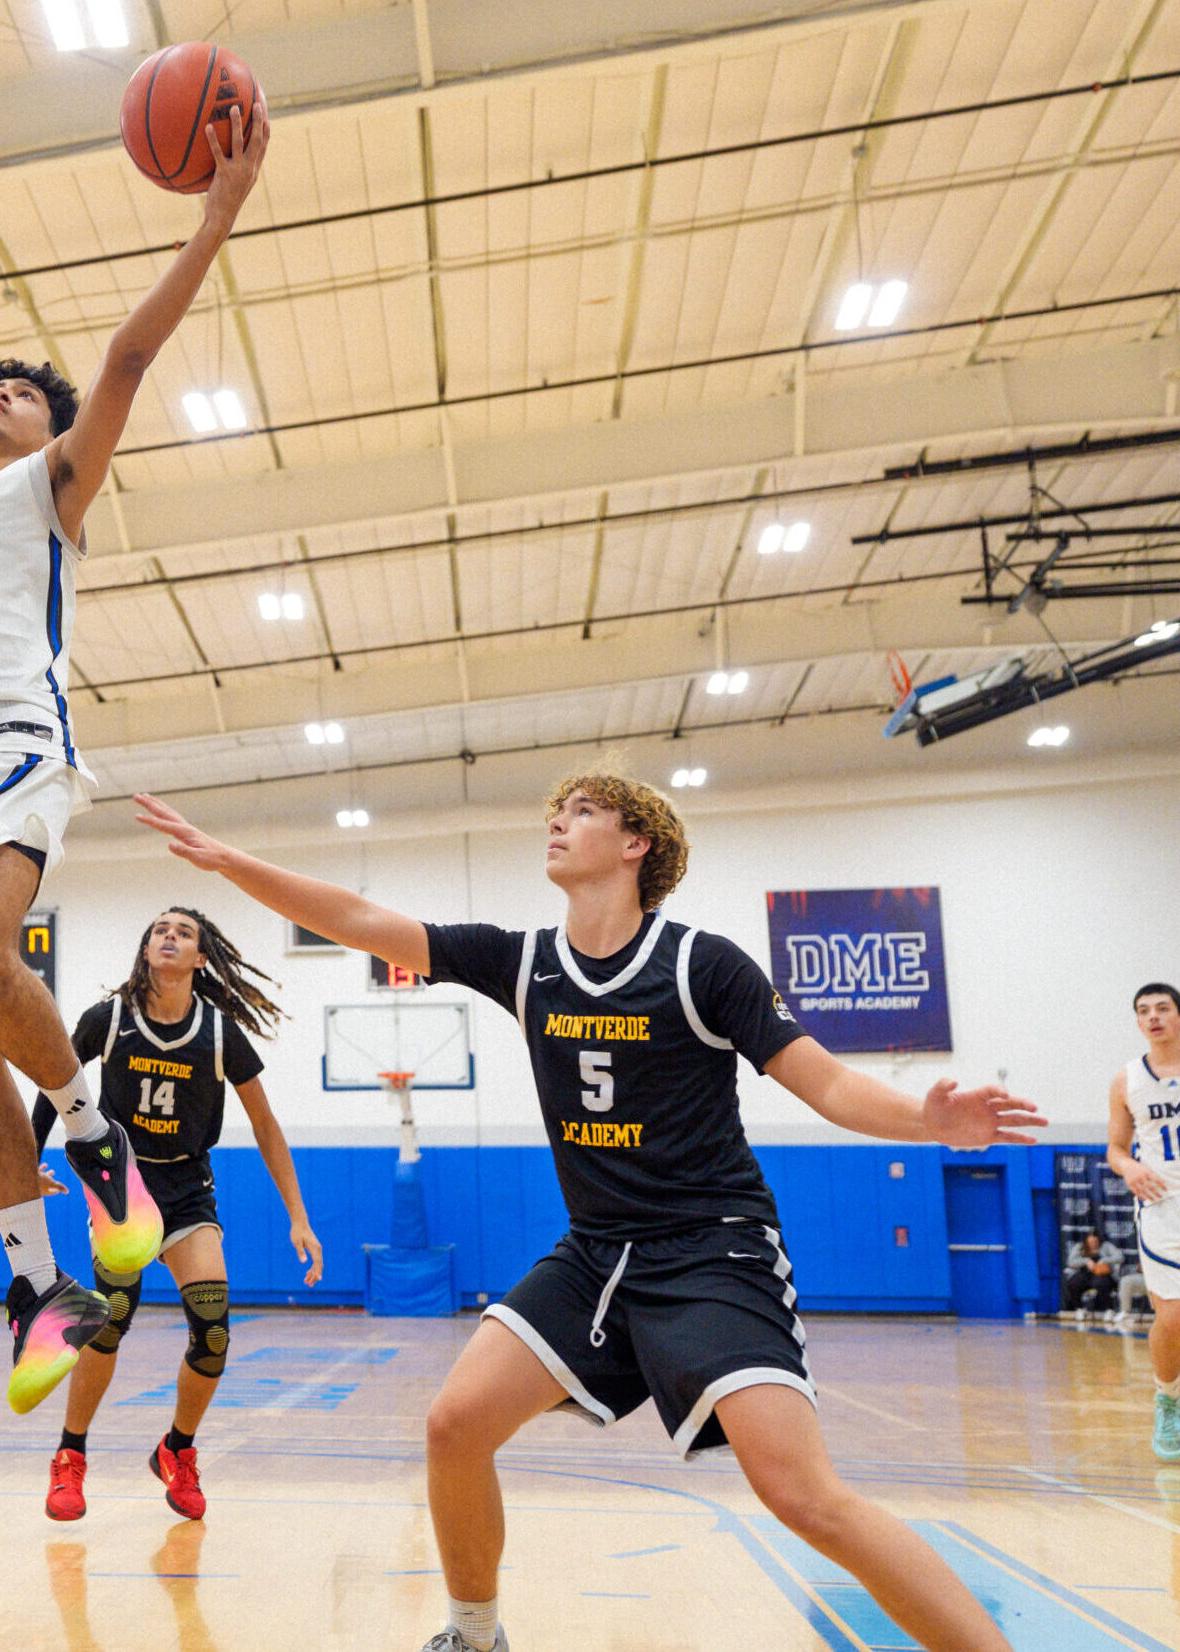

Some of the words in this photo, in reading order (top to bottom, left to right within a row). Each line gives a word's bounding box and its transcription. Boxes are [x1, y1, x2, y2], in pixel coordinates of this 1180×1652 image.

[786, 932, 930, 994] DME
[800, 996, 853, 1012] SPORTS
[855, 995, 921, 1011] ACADEMY
[544, 1013, 651, 1041] MONTVERDE
[128, 1055, 193, 1079] MONTVERDE
[578, 1050, 614, 1112] 5
[138, 1077, 176, 1116] 14
[133, 1113, 181, 1135] ACADEMY
